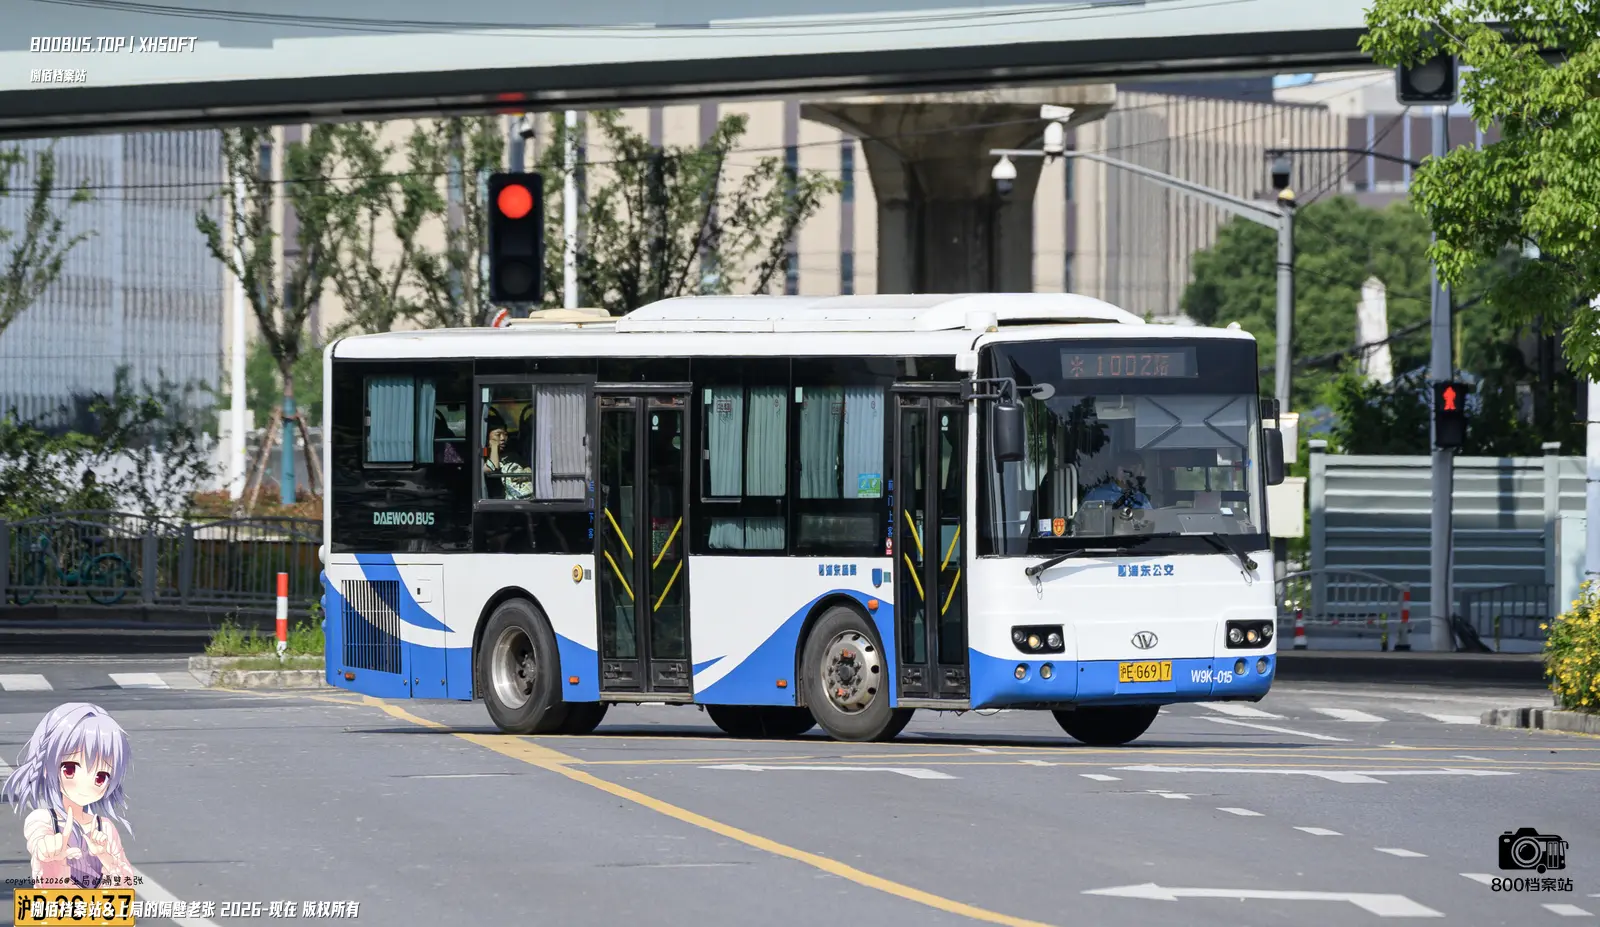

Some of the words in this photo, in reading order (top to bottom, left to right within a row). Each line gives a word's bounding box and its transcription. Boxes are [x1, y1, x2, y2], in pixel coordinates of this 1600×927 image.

[373, 511, 415, 526] DAEWOO
[415, 511, 435, 526] BUS
[1128, 563, 1174, 577] 浦东公交
[1190, 669, 1233, 684] W9K-015
